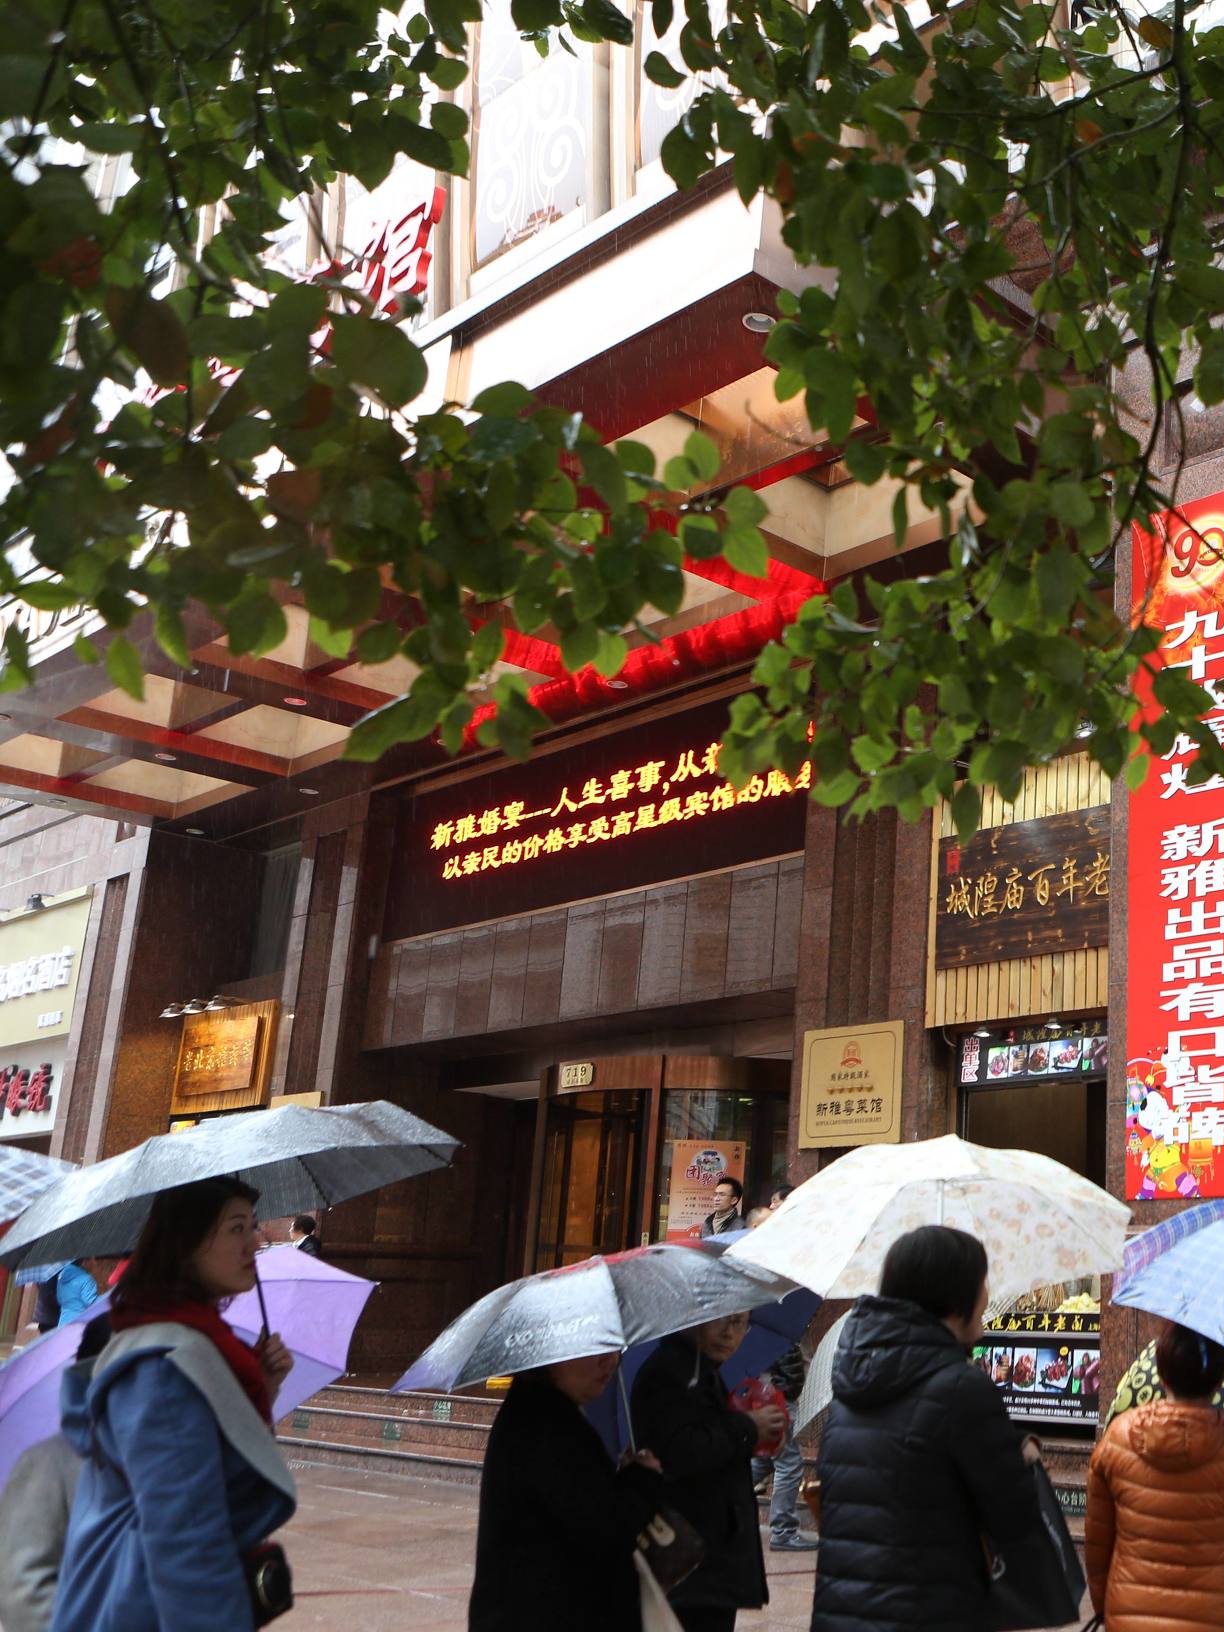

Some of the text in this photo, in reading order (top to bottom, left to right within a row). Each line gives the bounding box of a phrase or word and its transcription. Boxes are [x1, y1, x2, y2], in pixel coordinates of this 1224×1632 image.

[946, 852, 1110, 920] 城隍庙百年老
[566, 1066, 587, 1078] 719
[816, 1098, 884, 1117] 新雅粤菜馆
